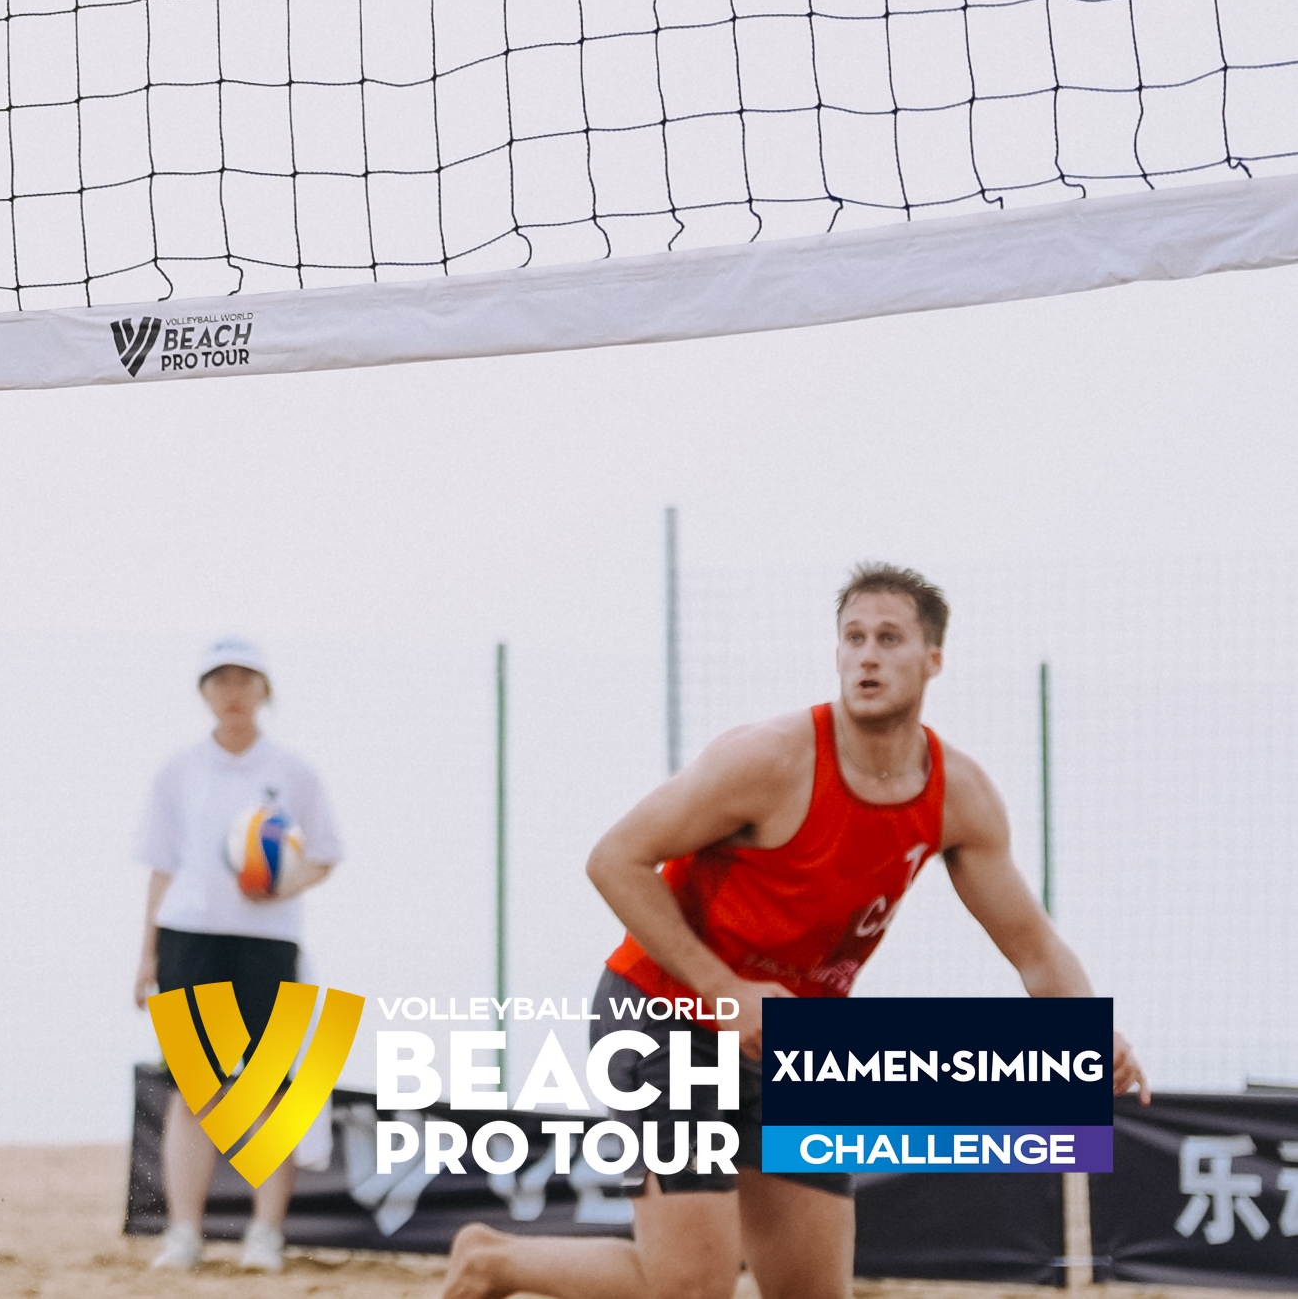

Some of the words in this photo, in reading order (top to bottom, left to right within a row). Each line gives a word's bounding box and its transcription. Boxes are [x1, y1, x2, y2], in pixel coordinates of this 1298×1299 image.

[165, 315, 219, 326] VOLLEYBALL
[220, 312, 254, 322] WORLD
[162, 323, 252, 352] BEACH
[161, 352, 199, 371] PRO
[201, 349, 250, 368] TOUR
